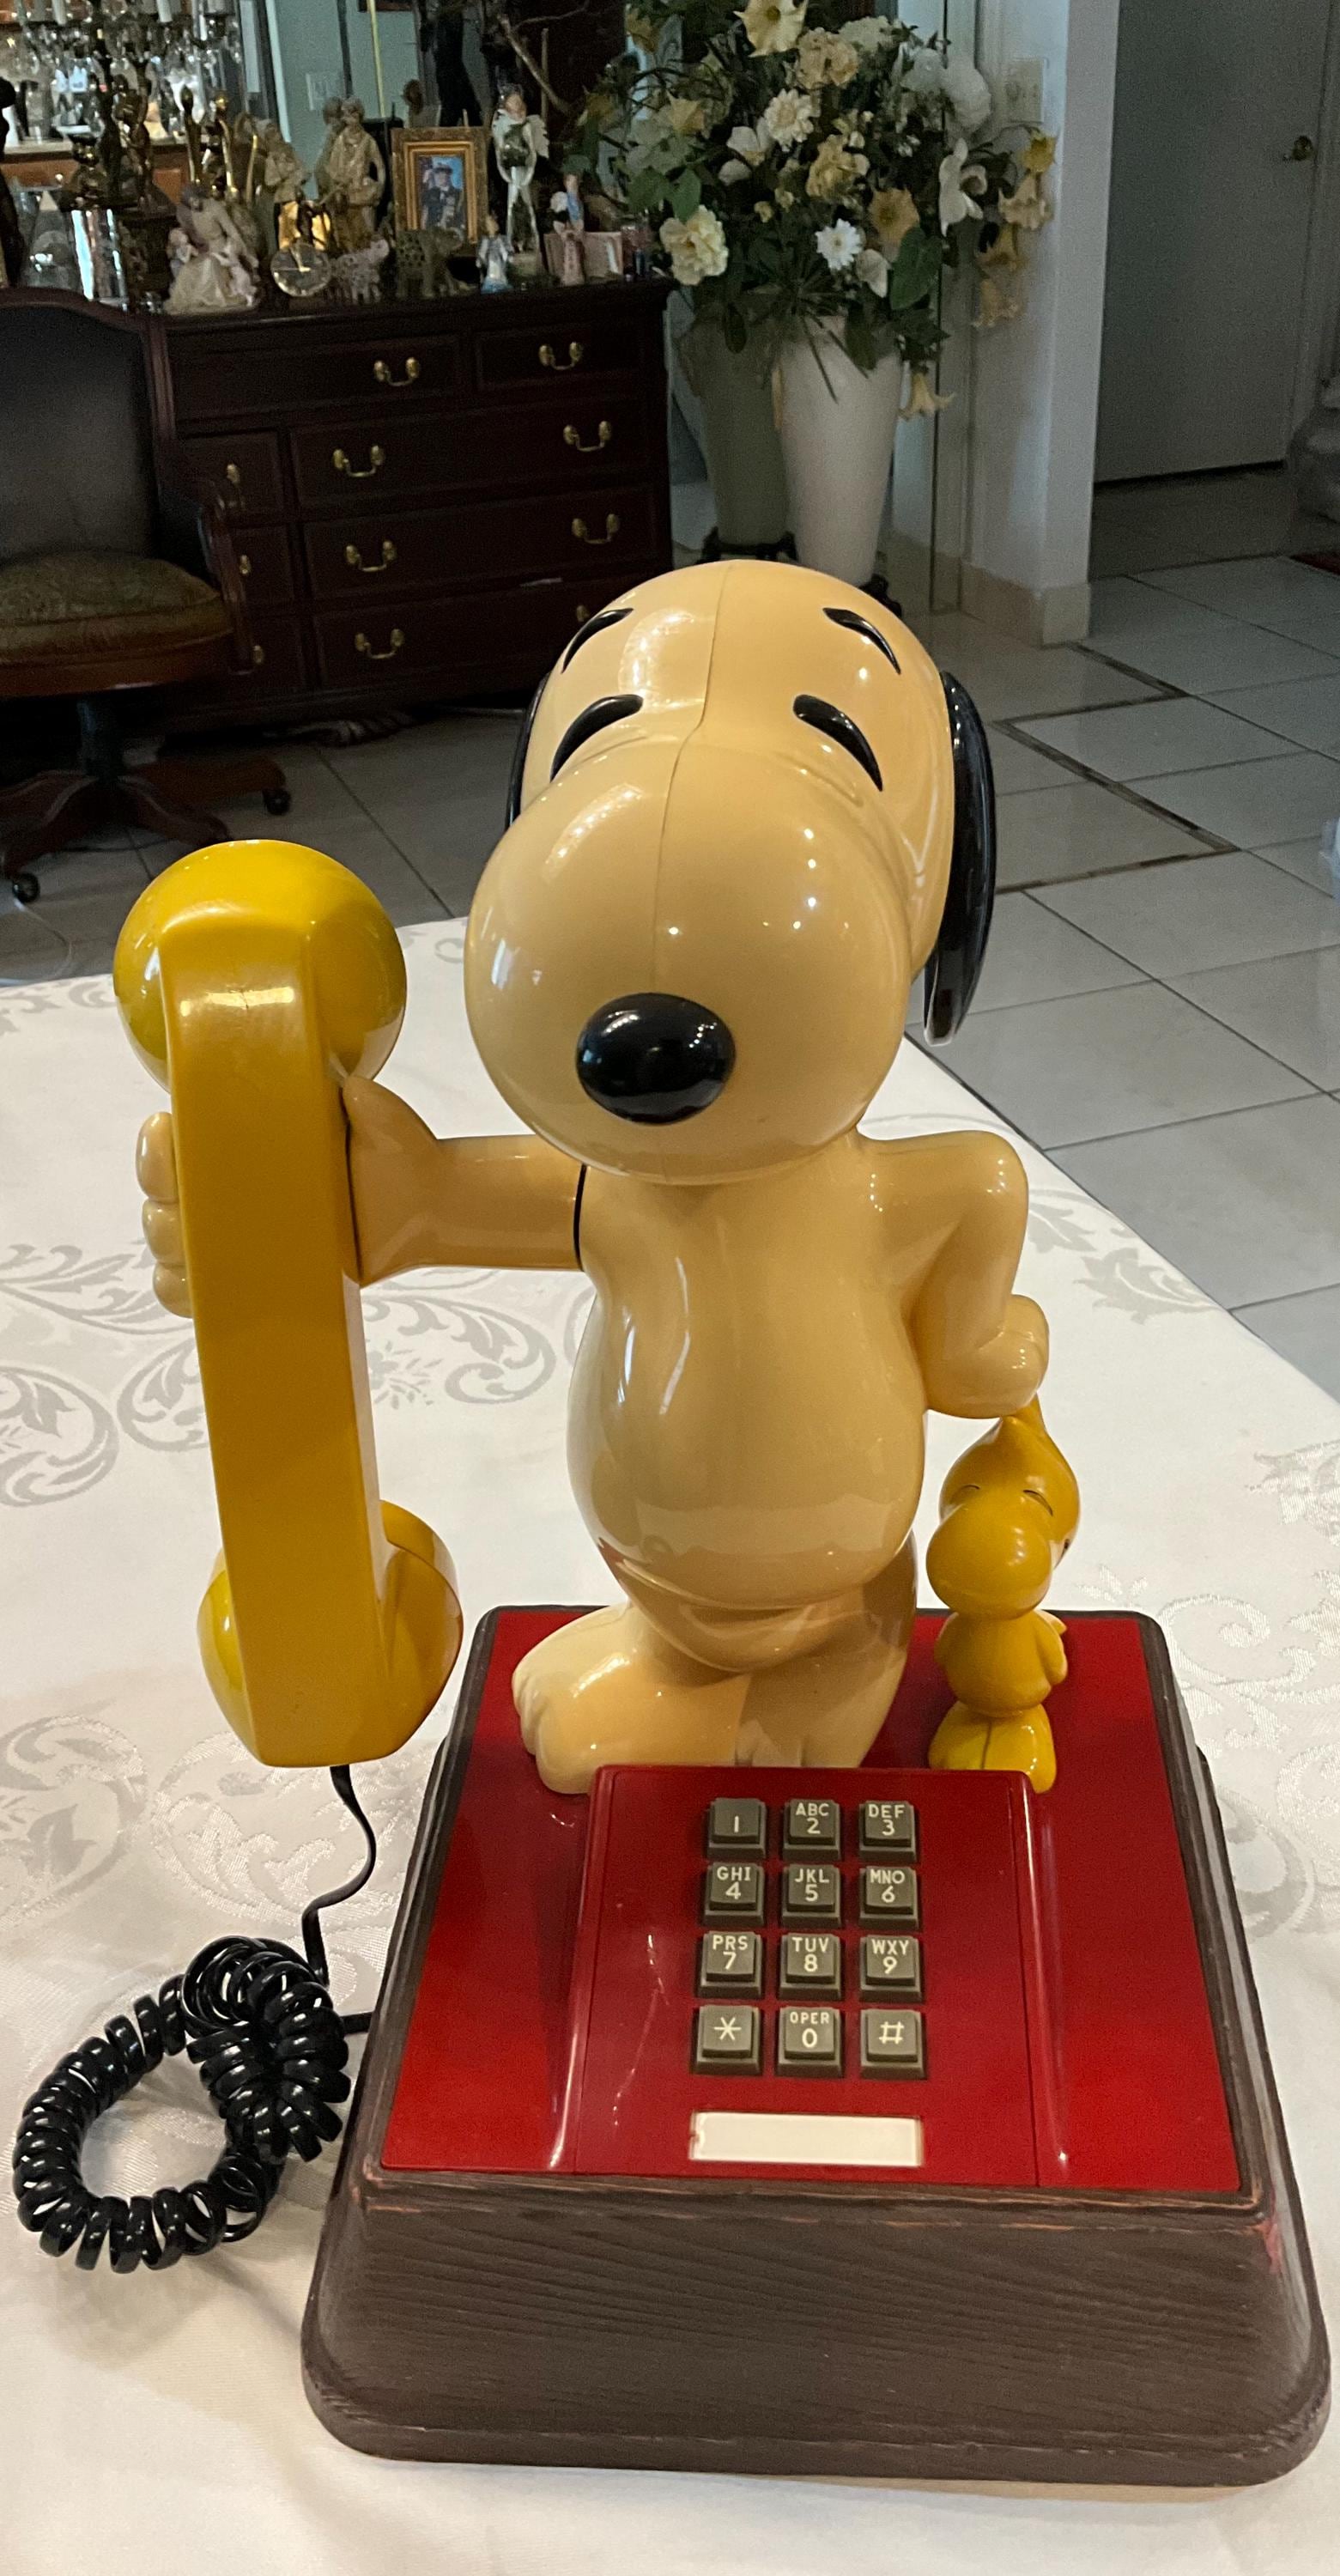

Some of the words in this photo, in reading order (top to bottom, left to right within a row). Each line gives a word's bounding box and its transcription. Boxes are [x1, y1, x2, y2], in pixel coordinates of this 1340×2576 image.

[795, 1802, 829, 1817] ABC
[869, 1804, 905, 1819] DEF
[734, 1815, 740, 1833] 1
[807, 1818, 821, 1835] 2
[882, 1820, 895, 1836] 3
[716, 1867, 751, 1881] GHI
[794, 1868, 829, 1884] JKL
[870, 1870, 905, 1885] MNO
[725, 1882, 741, 1900] 4
[804, 1884, 818, 1902] 5
[881, 1886, 895, 1903] 6
[712, 1935, 748, 1951] PRS
[791, 1936, 829, 1953] TUV
[871, 1939, 909, 1956] WXY
[723, 1952, 737, 1970] 7
[803, 1953, 818, 1972] 8
[882, 1956, 897, 1974] 9
[789, 2011, 830, 2025] OPER
[801, 2028, 818, 2049] 0
